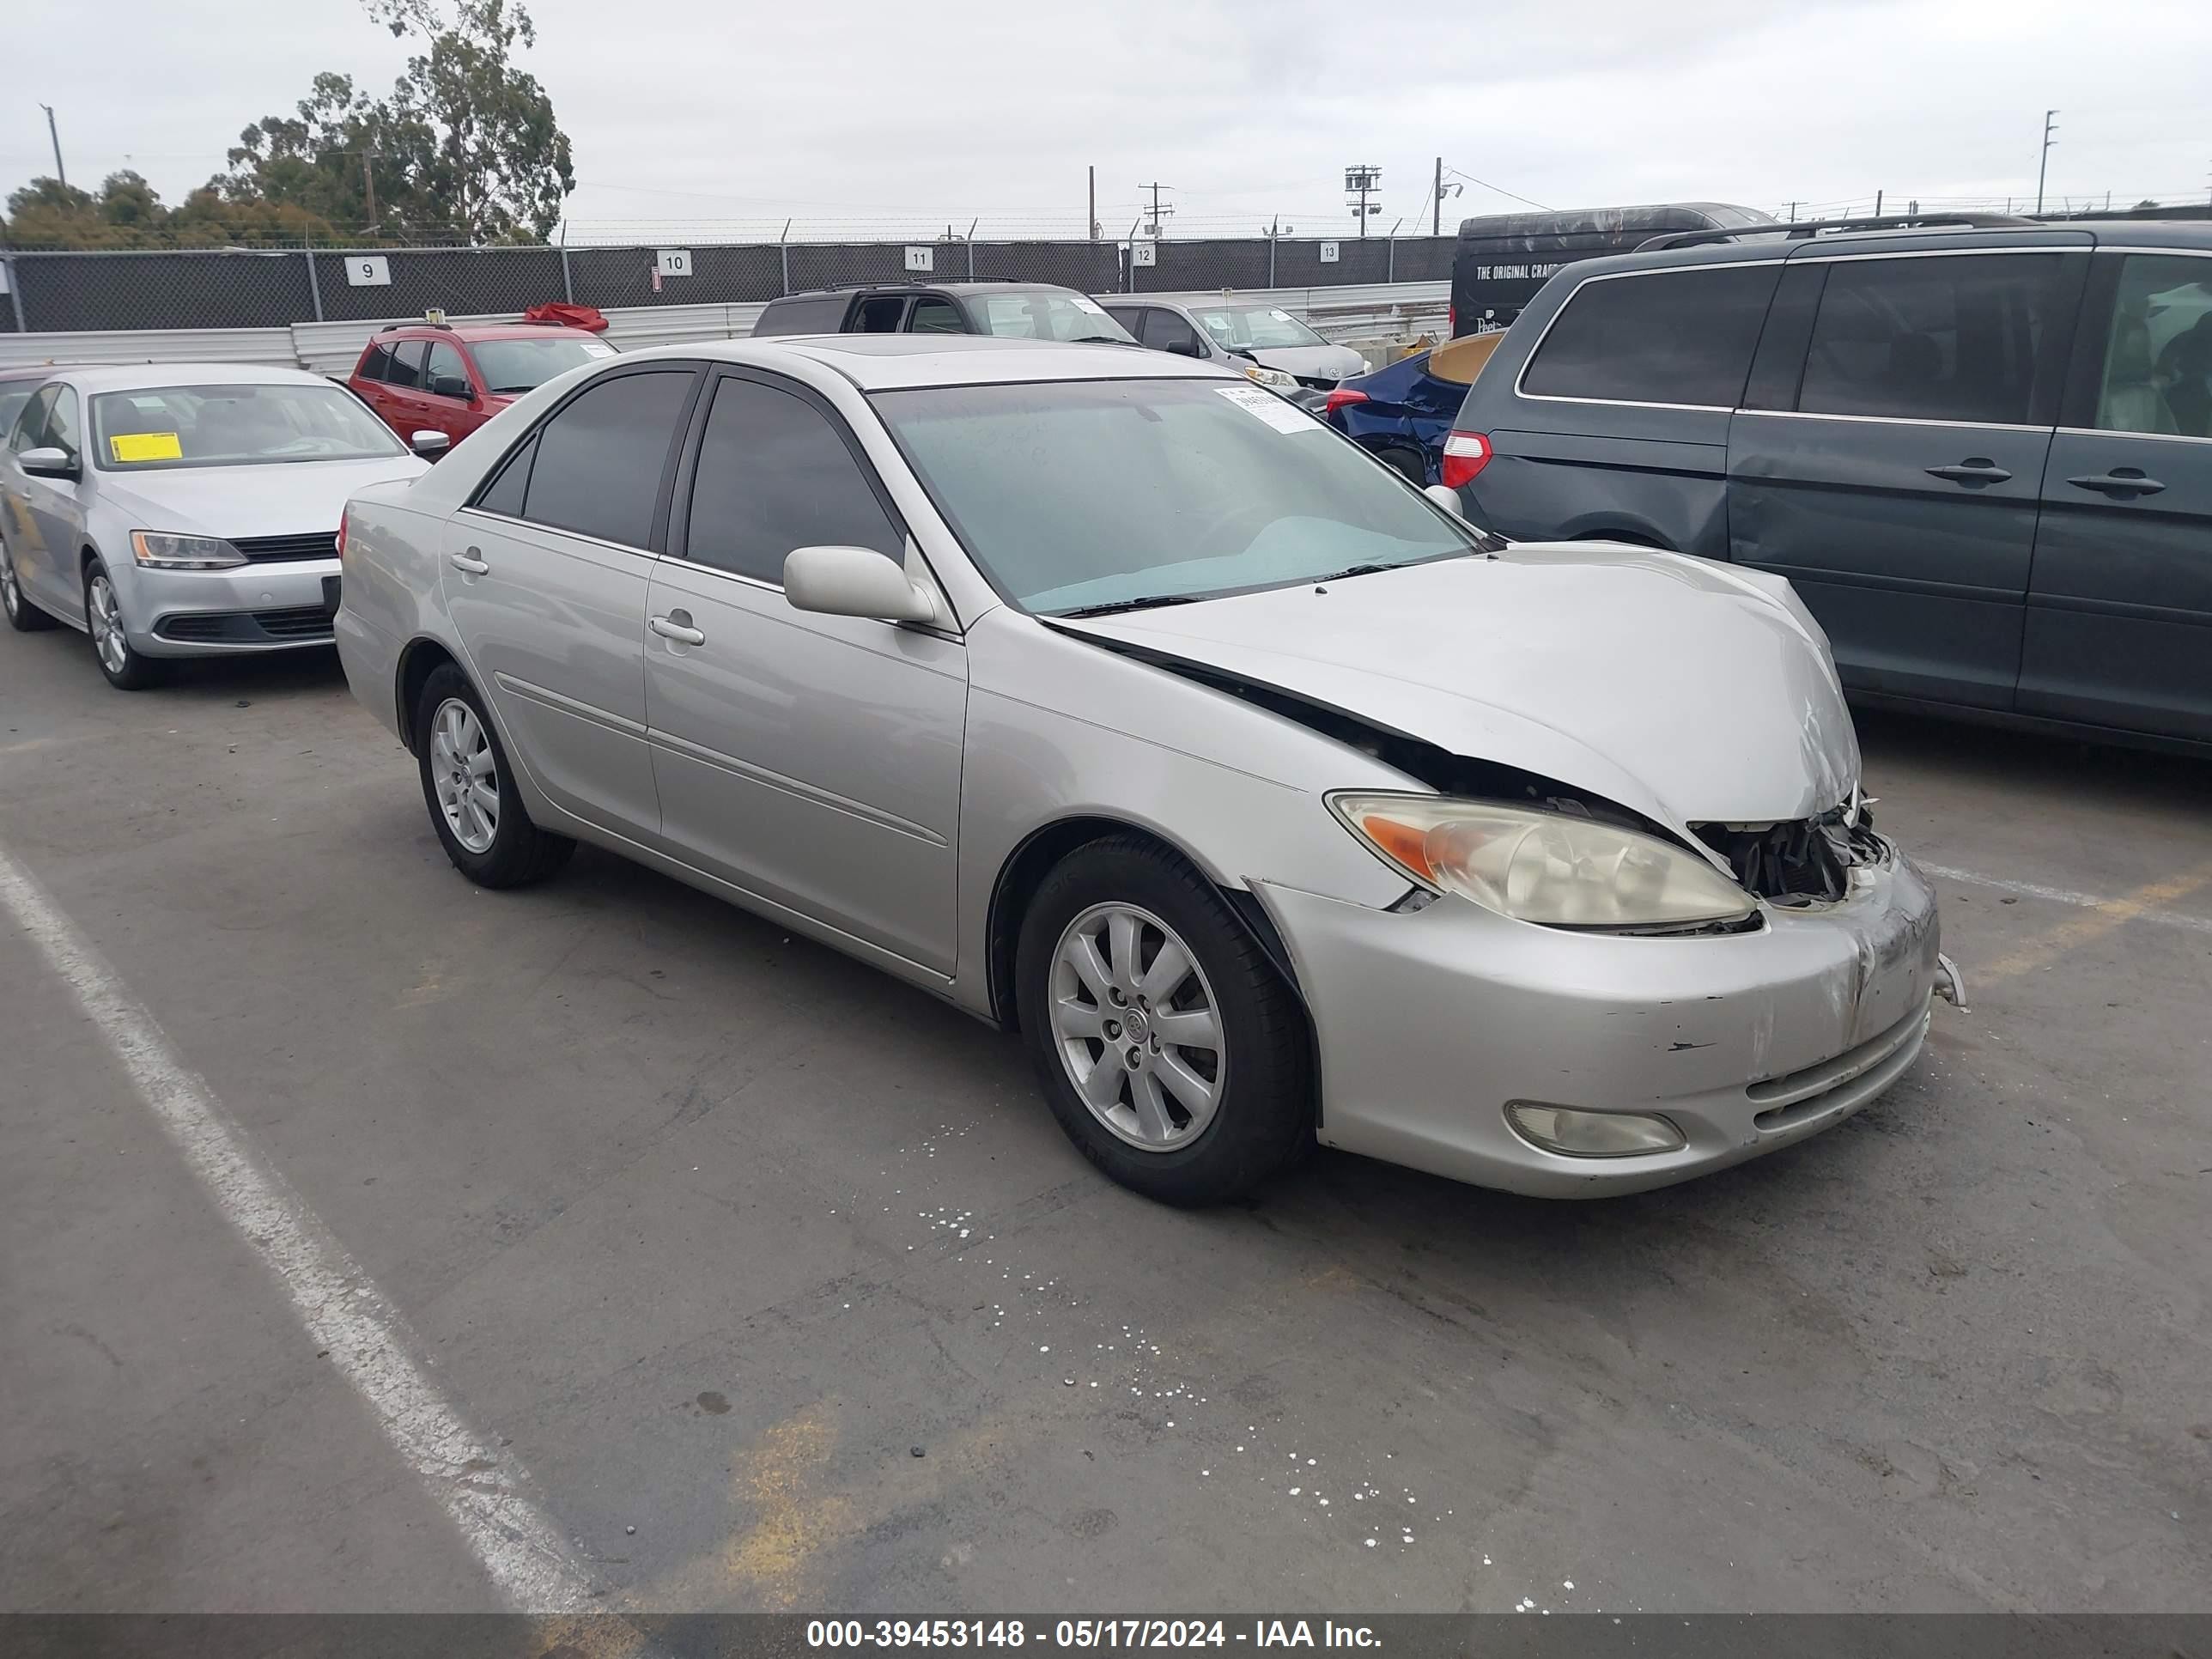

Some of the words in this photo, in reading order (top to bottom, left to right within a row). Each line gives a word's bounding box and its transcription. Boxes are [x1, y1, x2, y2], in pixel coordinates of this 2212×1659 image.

[913, 252, 925, 265] 11
[1138, 250, 1150, 261] 12
[1325, 246, 1334, 258] 13
[666, 256, 683, 270] 10
[362, 264, 373, 278] 9
[1477, 266, 1492, 280] THE
[1493, 264, 1529, 279] ORIGINAL
[1531, 264, 1559, 278] CRA
